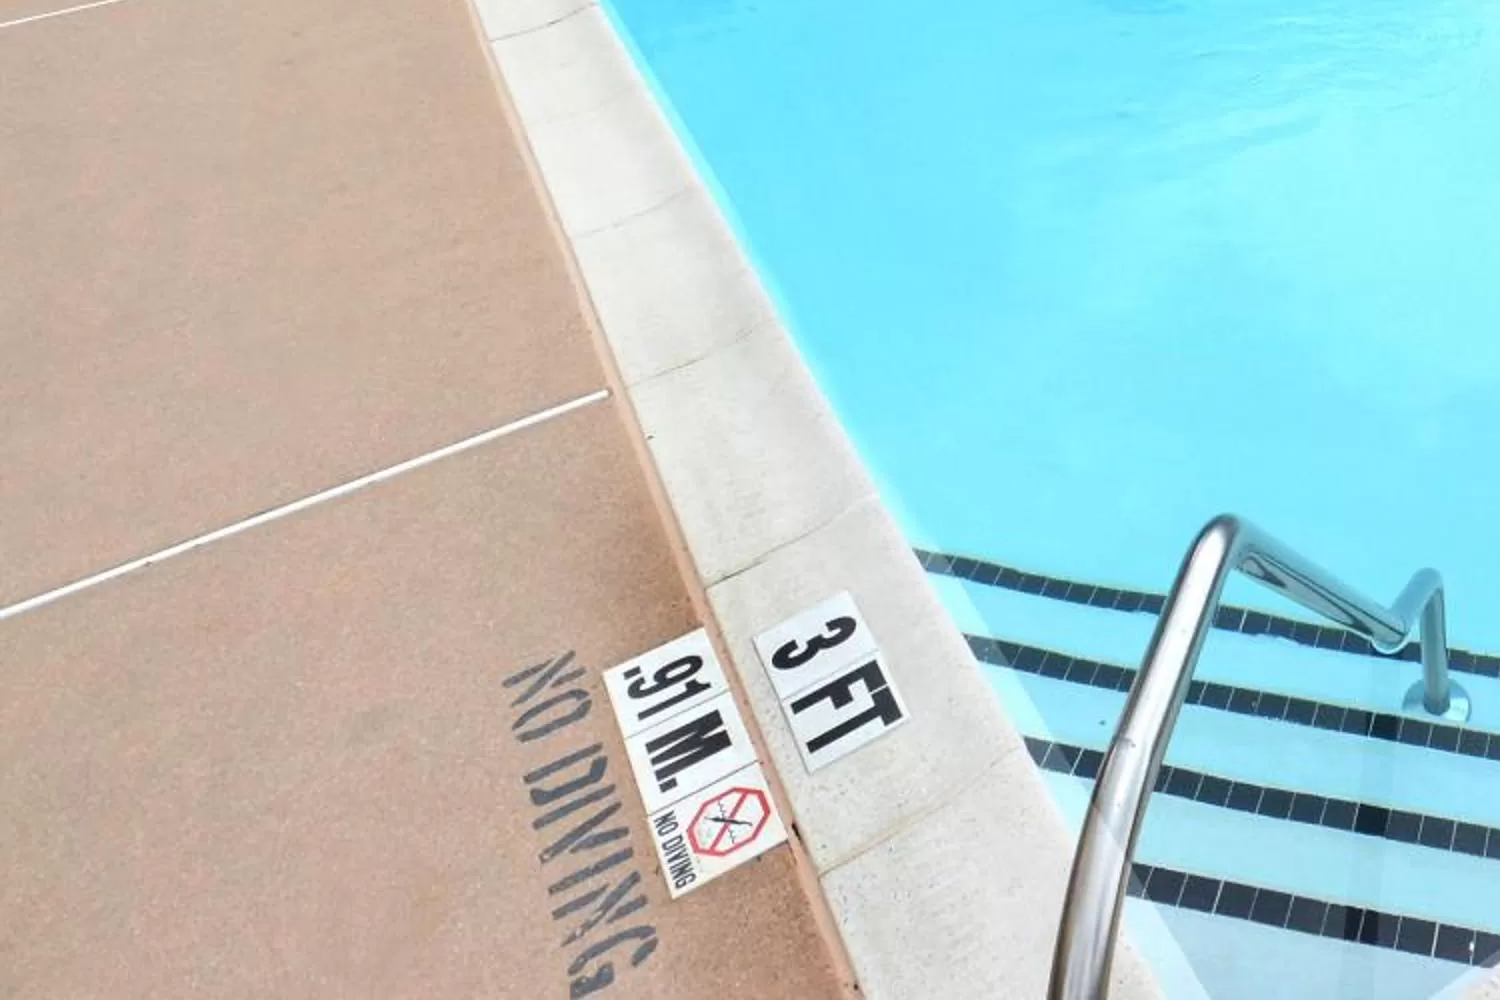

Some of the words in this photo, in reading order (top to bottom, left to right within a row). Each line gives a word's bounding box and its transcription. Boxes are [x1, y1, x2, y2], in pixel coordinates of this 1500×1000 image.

[771, 615, 858, 670] 3
[502, 650, 592, 743] NO
[623, 655, 712, 721] .91
[790, 658, 904, 754] FT
[645, 709, 733, 793] M.
[653, 810, 679, 836] NO
[523, 741, 660, 1000] DIVING
[661, 834, 697, 890] DIVING
